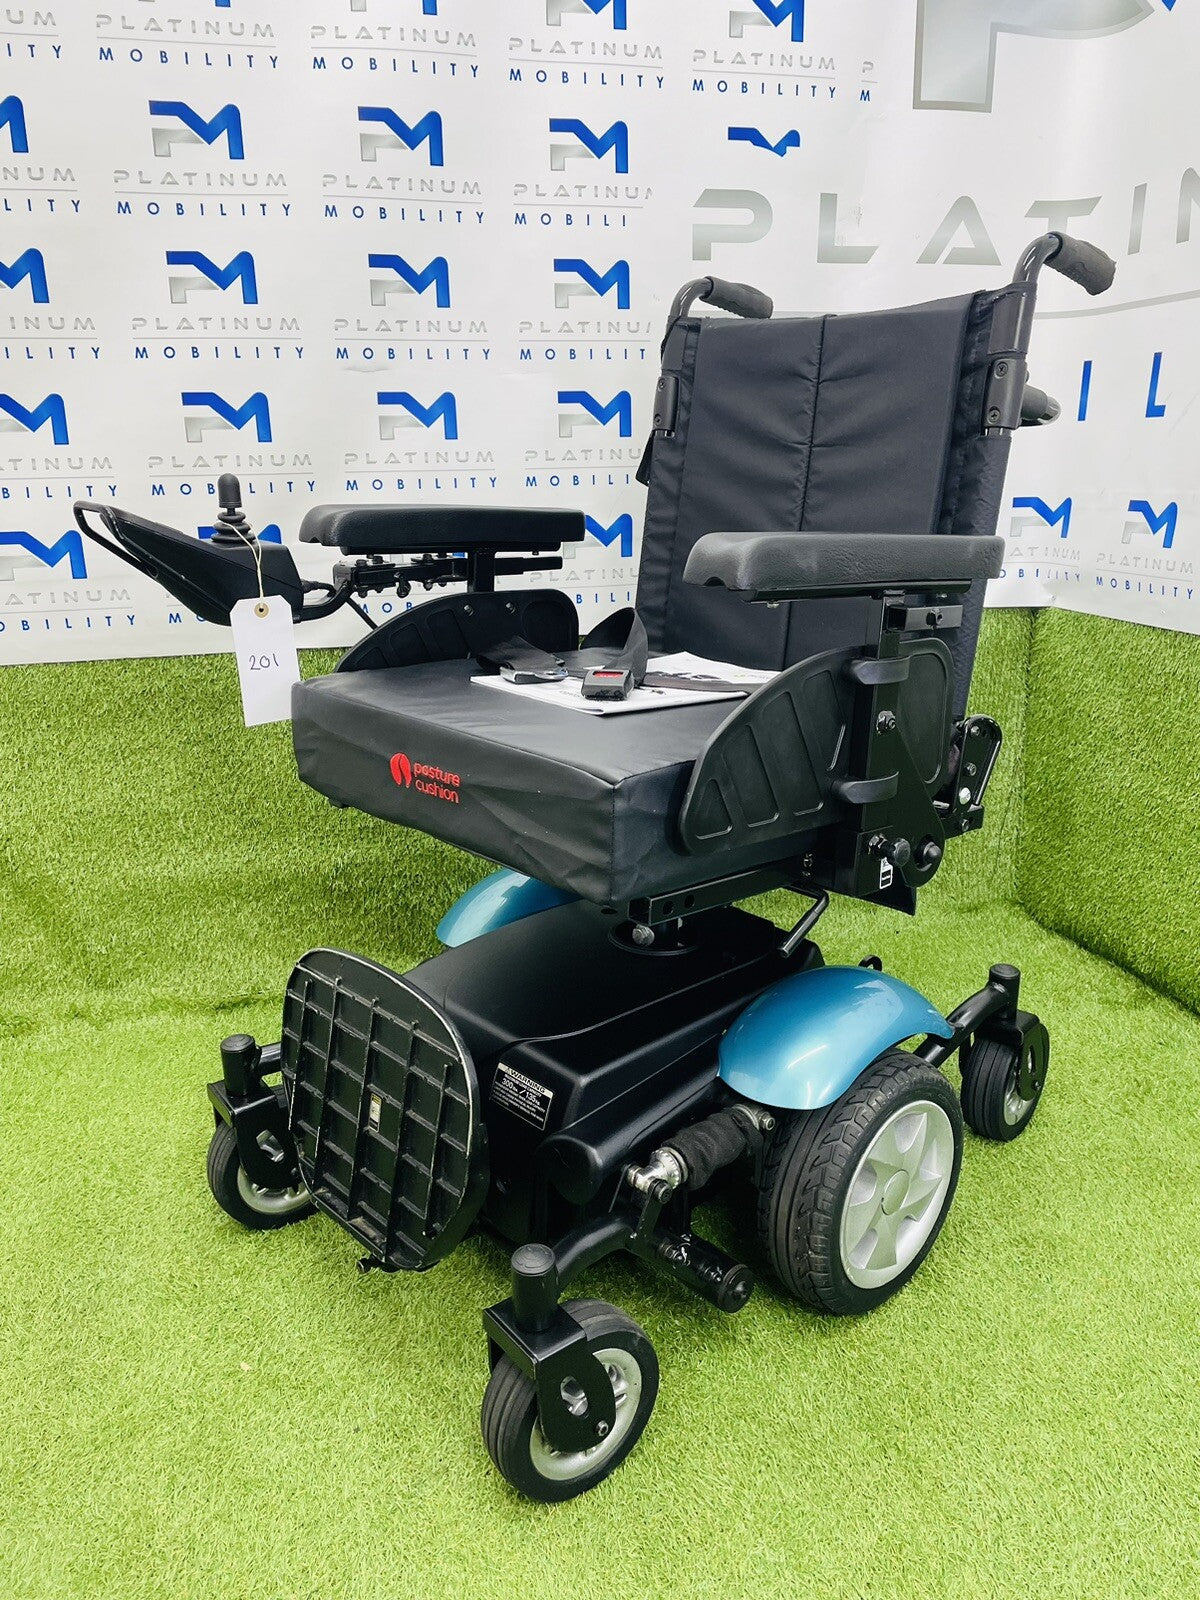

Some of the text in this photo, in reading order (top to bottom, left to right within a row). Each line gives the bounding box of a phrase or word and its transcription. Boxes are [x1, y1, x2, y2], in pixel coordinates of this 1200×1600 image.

[96, 14, 274, 38] PLATINUM
[311, 26, 476, 48] PLATINUM
[99, 47, 277, 68] MOBILITY
[509, 37, 662, 59] PLATINUM
[313, 57, 478, 77] MOBILITY
[693, 49, 835, 71] PLATINUM
[510, 68, 663, 88] MOBILITY
[693, 79, 835, 98] MOBILITY
[114, 170, 286, 186] PLATINUM
[323, 174, 481, 195] PLATINUM
[118, 201, 290, 216] MOBILITY
[325, 205, 483, 223] MOBILITY
[515, 213, 625, 226] MOBILI
[132, 317, 300, 330] PLATINUM
[335, 319, 487, 333] PLATINUM
[135, 346, 303, 358] MOBILITY
[337, 347, 489, 360] MOBILITY
[520, 349, 645, 360] MOBILIT
[0, 457, 112, 471] TINUM
[149, 454, 312, 468] PLATINUM
[344, 451, 494, 465] PLATINUM
[152, 481, 315, 495] MOBLITY
[346, 477, 496, 490] MOBILITY
[1096, 553, 1193, 574] PLATINUM
[1097, 577, 1193, 599] MOBILITY
[248, 652, 280, 671] 201
[414, 762, 460, 787] posture
[416, 780, 459, 803] cushion
[510, 1069, 546, 1093] WARNING
